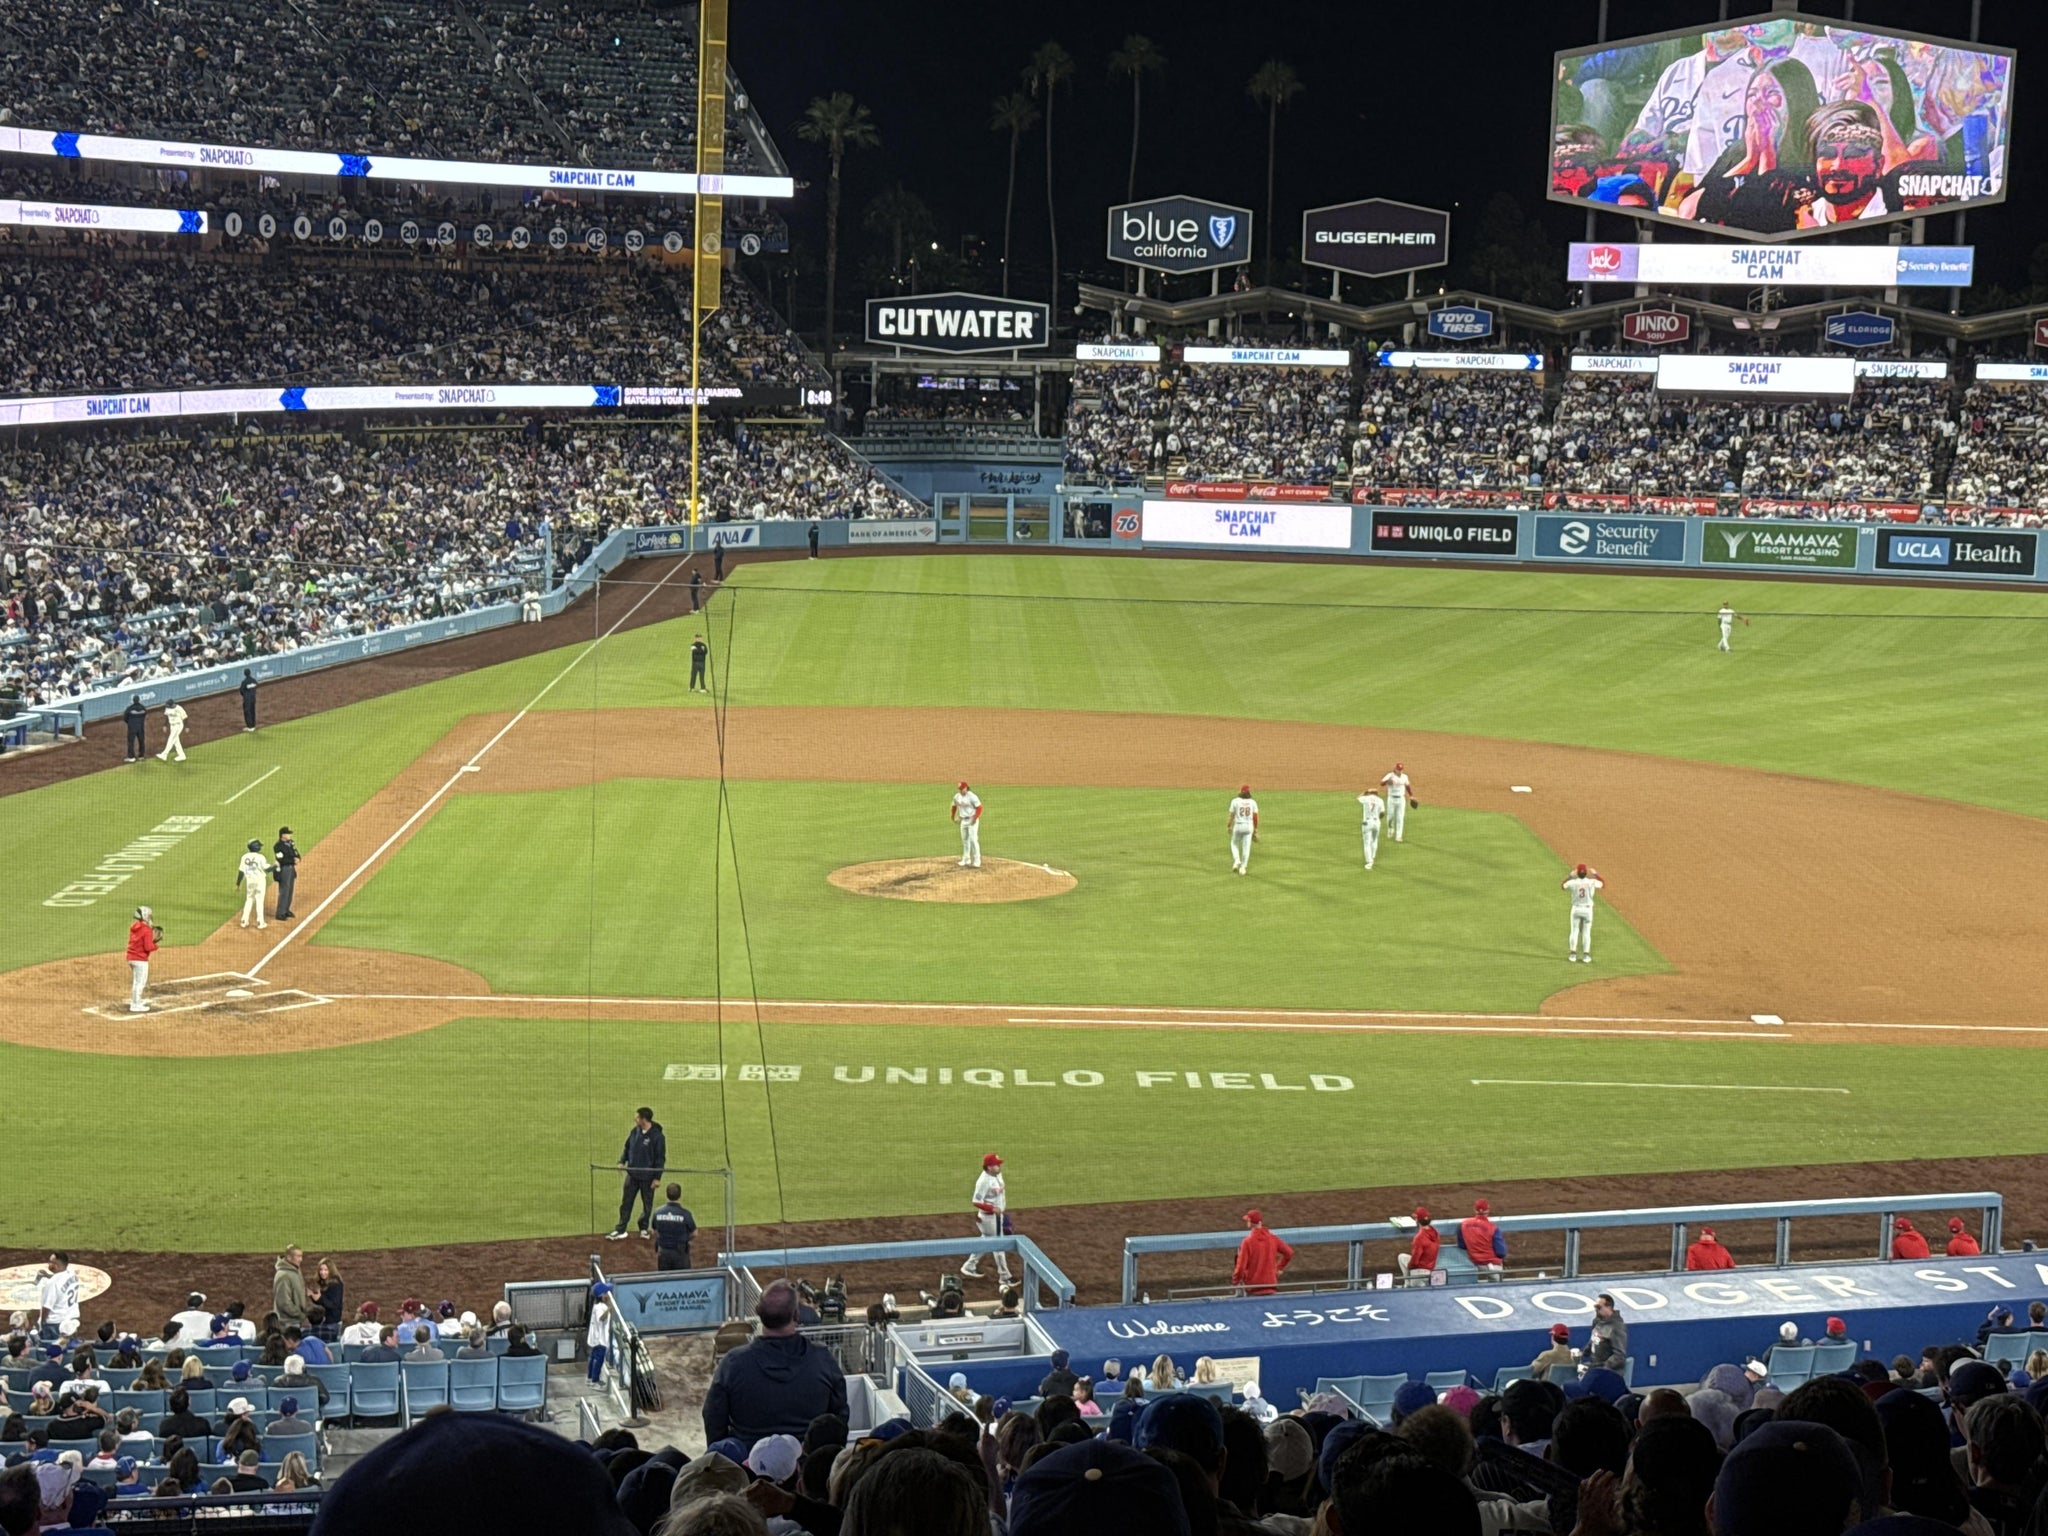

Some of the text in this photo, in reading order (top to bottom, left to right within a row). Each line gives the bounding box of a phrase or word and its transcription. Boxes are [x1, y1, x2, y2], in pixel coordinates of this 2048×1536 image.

[200, 148, 244, 165] SNAPCHAT
[549, 170, 635, 187] SNAPCHAT CAM
[1899, 174, 1983, 198] SNAPCHAT
[55, 207, 92, 223] SNAPCHAT
[232, 218, 236, 232] 1
[264, 220, 271, 233] 2
[299, 221, 306, 234] 4
[332, 223, 343, 236] 14
[369, 225, 379, 237] 19
[1123, 210, 1199, 242] blue
[403, 226, 417, 239] 20
[440, 227, 455, 240] 24
[476, 229, 491, 242] 32
[514, 231, 528, 243] 34
[551, 232, 565, 244] 39
[588, 232, 604, 246] 42
[1315, 231, 1436, 245] GUGGENHEIM
[627, 235, 641, 247] 53
[1134, 244, 1207, 258] california
[1731, 250, 1802, 265] SNAPCHAT
[1588, 248, 1620, 269] Jack
[1747, 265, 1783, 279] CAM
[1908, 261, 1940, 272] Security
[879, 308, 1033, 339] CUTWATER
[1437, 313, 1476, 323] TOYO
[1442, 324, 1484, 334] TIRES
[1634, 316, 1679, 336] JINRO
[1848, 325, 1891, 334] ELDRIDGE
[1646, 332, 1665, 340] SOJU
[1092, 347, 1134, 357] SNAPCHAT
[1232, 351, 1300, 361] SNAPCHAT CAM
[1455, 355, 1496, 366] SNAPCHAT
[1588, 358, 1634, 369] SNAPCHAT
[1728, 363, 1782, 374] SNAPCHAT
[1740, 374, 1768, 384] CAM
[438, 389, 485, 403] SNAPCHAT
[86, 397, 150, 416] SNAPCHAT CAM
[1214, 509, 1277, 524] SNAPCHAT
[1117, 516, 1139, 532] 76
[1229, 523, 1262, 537] CAM
[712, 530, 740, 545] ANA
[1409, 525, 1463, 542] UNIQLO
[1468, 527, 1512, 542] FIELD
[1596, 522, 1659, 543] Security
[1596, 540, 1649, 556] Benefit
[1754, 546, 1792, 555] RESORT
[1802, 548, 1840, 557] CASINO
[1897, 542, 2022, 564] UCLA Health
[42, 874, 133, 907] FIELD
[1579, 888, 1586, 899] 3
[834, 1065, 1356, 1092] UNIQLO FIELD
[1454, 1263, 2048, 1320] DODGER ST
[1262, 1304, 1391, 1329] ようこそ
[1107, 1318, 1231, 1340] Welcome
